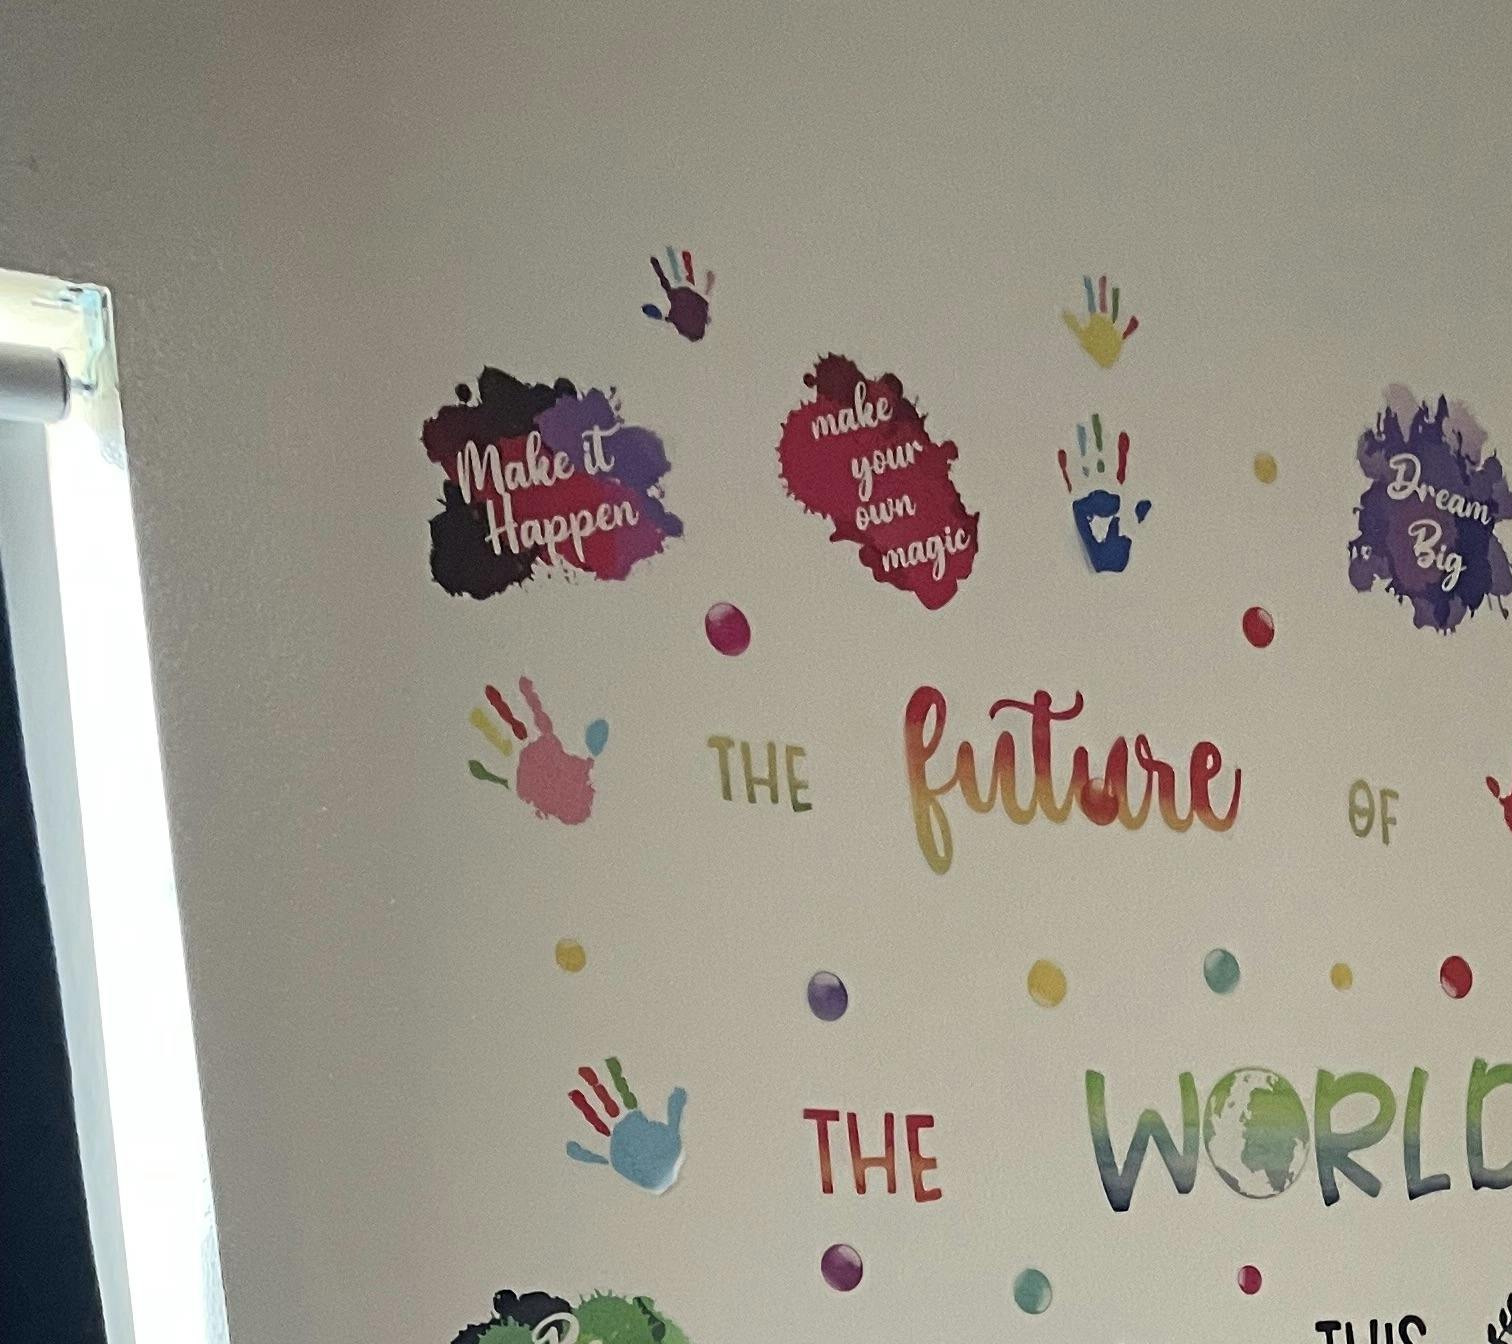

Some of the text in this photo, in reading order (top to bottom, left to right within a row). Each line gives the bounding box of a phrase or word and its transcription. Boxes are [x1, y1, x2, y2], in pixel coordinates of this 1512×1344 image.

[811, 382, 893, 440] make
[456, 422, 621, 503] Make it
[852, 439, 923, 499] your
[1387, 453, 1493, 526] Dream
[485, 492, 639, 561] Happen
[855, 493, 916, 531] own
[882, 524, 971, 581] magic
[1408, 519, 1466, 592] Big
[707, 685, 1400, 875] THE future OF
[803, 1108, 943, 1203] THE
